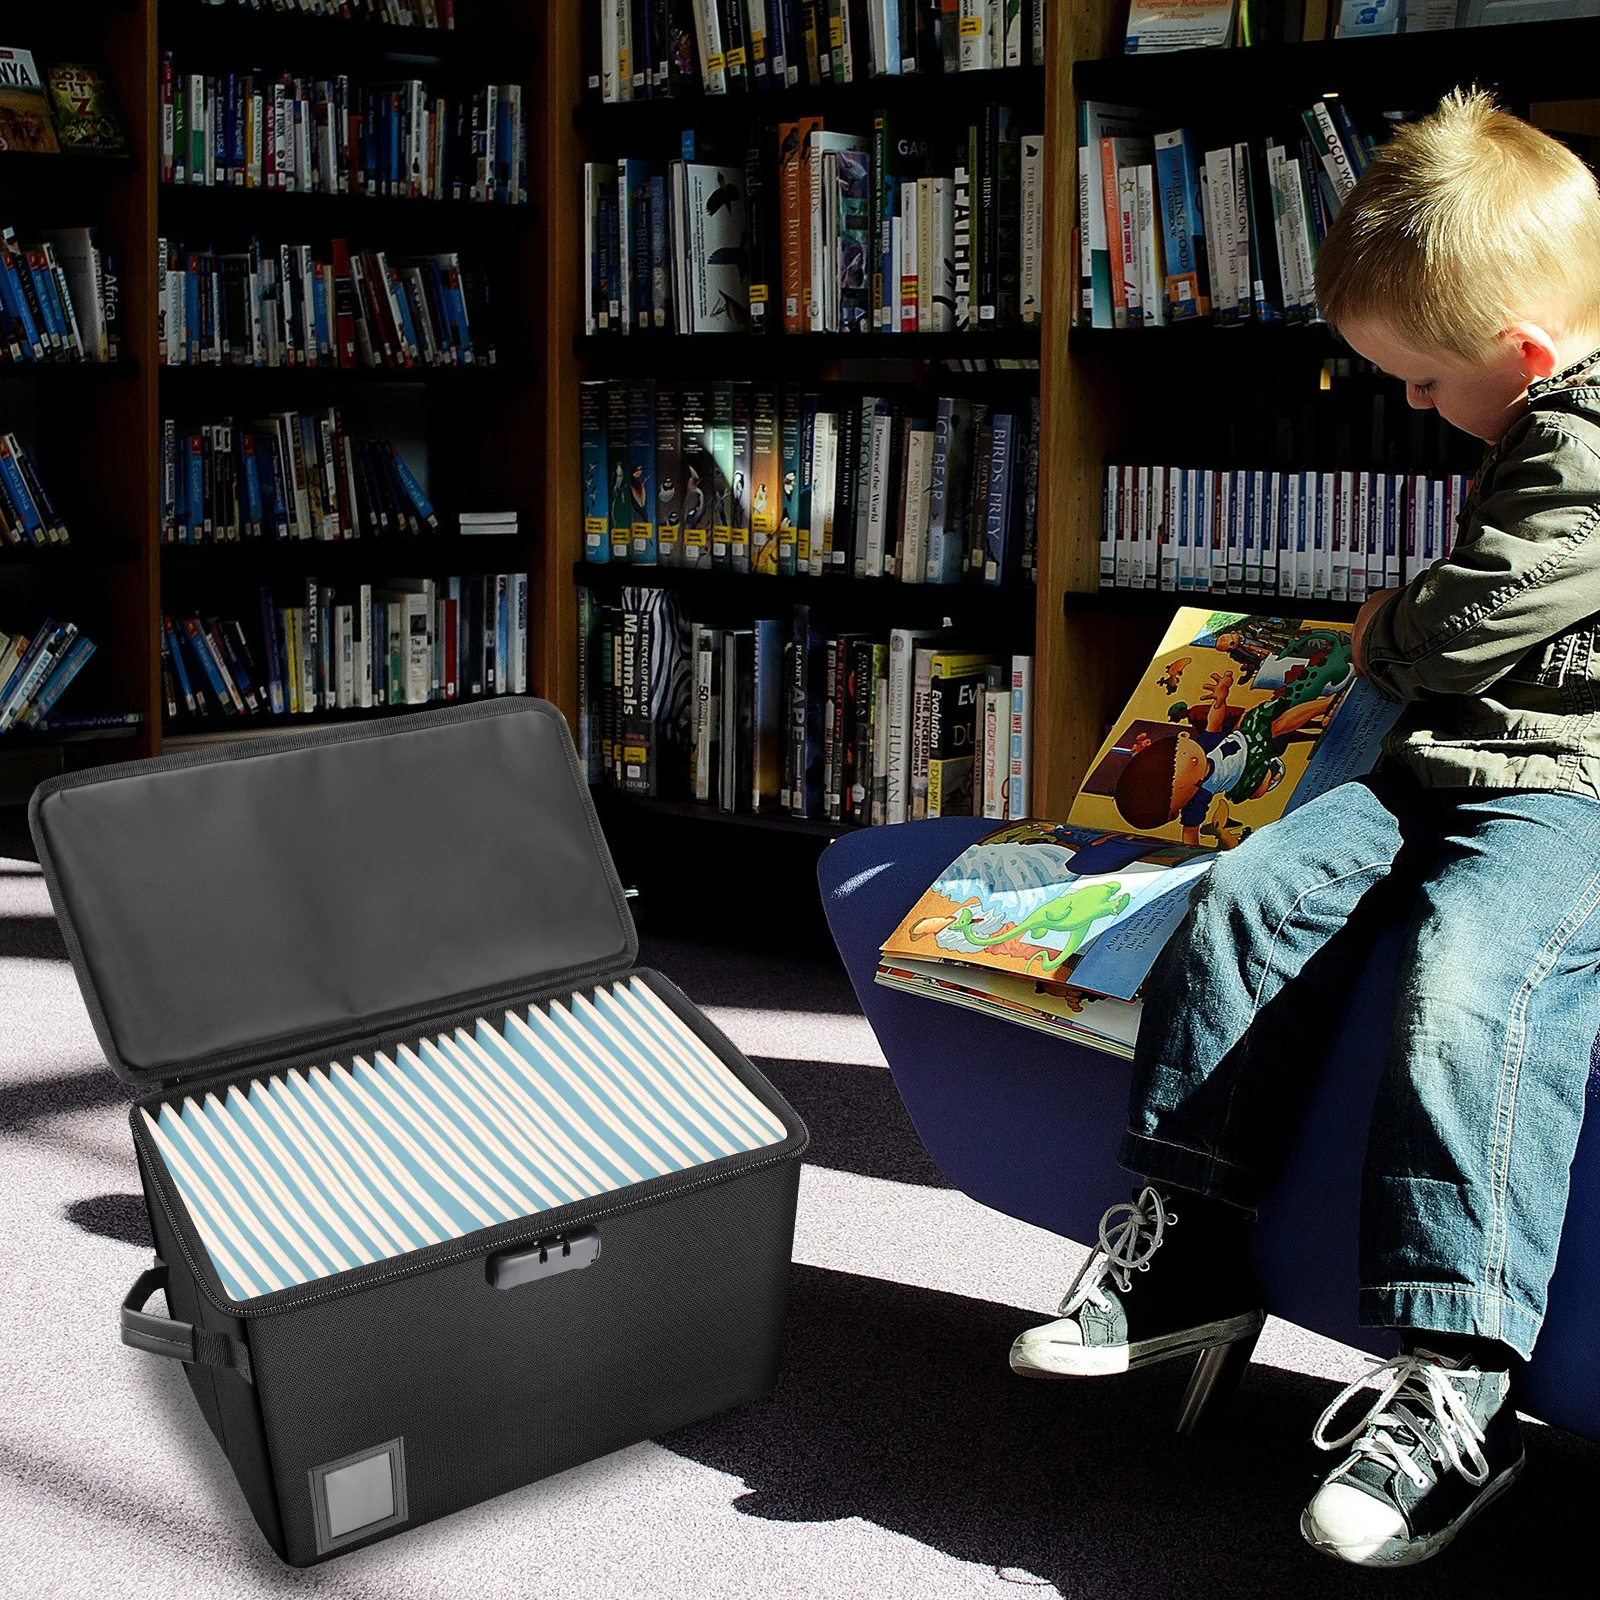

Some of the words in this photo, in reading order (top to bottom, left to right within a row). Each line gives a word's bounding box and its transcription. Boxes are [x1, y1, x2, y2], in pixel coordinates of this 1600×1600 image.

[216, 96, 224, 132] Eastern
[216, 133, 224, 154] USA
[236, 120, 244, 156] England
[1316, 110, 1329, 132] THE
[1325, 134, 1345, 165] OCD
[746, 149, 761, 197] Birds
[1081, 174, 1089, 194] MIND
[1219, 157, 1229, 178] The
[983, 177, 991, 208] BIRDS
[1081, 197, 1089, 220] OVER
[1106, 174, 1115, 209] Happy
[1172, 170, 1185, 226] FEELING
[1218, 182, 1231, 225] Courage
[1238, 167, 1246, 213] MOVING
[1026, 191, 1034, 235] WISDOM
[1166, 187, 1177, 238] HANDBOOK
[1238, 217, 1246, 234] ON
[636, 229, 648, 278] BRITAIN
[1027, 238, 1034, 251] OF
[1178, 229, 1189, 269] GOOD
[1226, 233, 1234, 245] to
[1025, 256, 1033, 286] BIRDS
[1227, 249, 1238, 275] Heal
[105, 273, 118, 320] Africa
[937, 415, 948, 444] ICE
[932, 454, 945, 499] BEAR
[992, 429, 1006, 483] BIRDS
[980, 454, 990, 500] Corvus
[871, 494, 879, 523] World
[988, 493, 1001, 539] PREY
[309, 583, 317, 643] ARCTIC
[623, 614, 638, 715] Mammals
[1013, 671, 1022, 688] YOUR
[641, 705, 648, 717] OF
[698, 685, 708, 701] 50
[793, 686, 804, 741] APE
[931, 690, 942, 749] Evolution
[1012, 714, 1022, 734] INNER
[1312, 769, 1324, 784] said
[1349, 702, 1362, 718] turn
[1358, 693, 1367, 703] to
[913, 733, 921, 777] JOURNEY
[921, 716, 929, 777] INCREDIBLE
[1335, 746, 1358, 778] Climbing
[1354, 734, 1365, 747] Up
[1361, 708, 1379, 733] Display
[1346, 751, 1366, 777] Sliding
[1361, 739, 1372, 751] On
[1368, 723, 1381, 739] The
[888, 725, 901, 804] HUMAN
[1012, 760, 1021, 776] FISH
[930, 770, 939, 810] DUMMIE
[1106, 932, 1121, 950] After
[1123, 931, 1134, 942] off
[1131, 916, 1145, 932] back
[1126, 936, 1140, 950] But
[1143, 911, 1161, 931] wasn't
[1160, 897, 1174, 912] long
